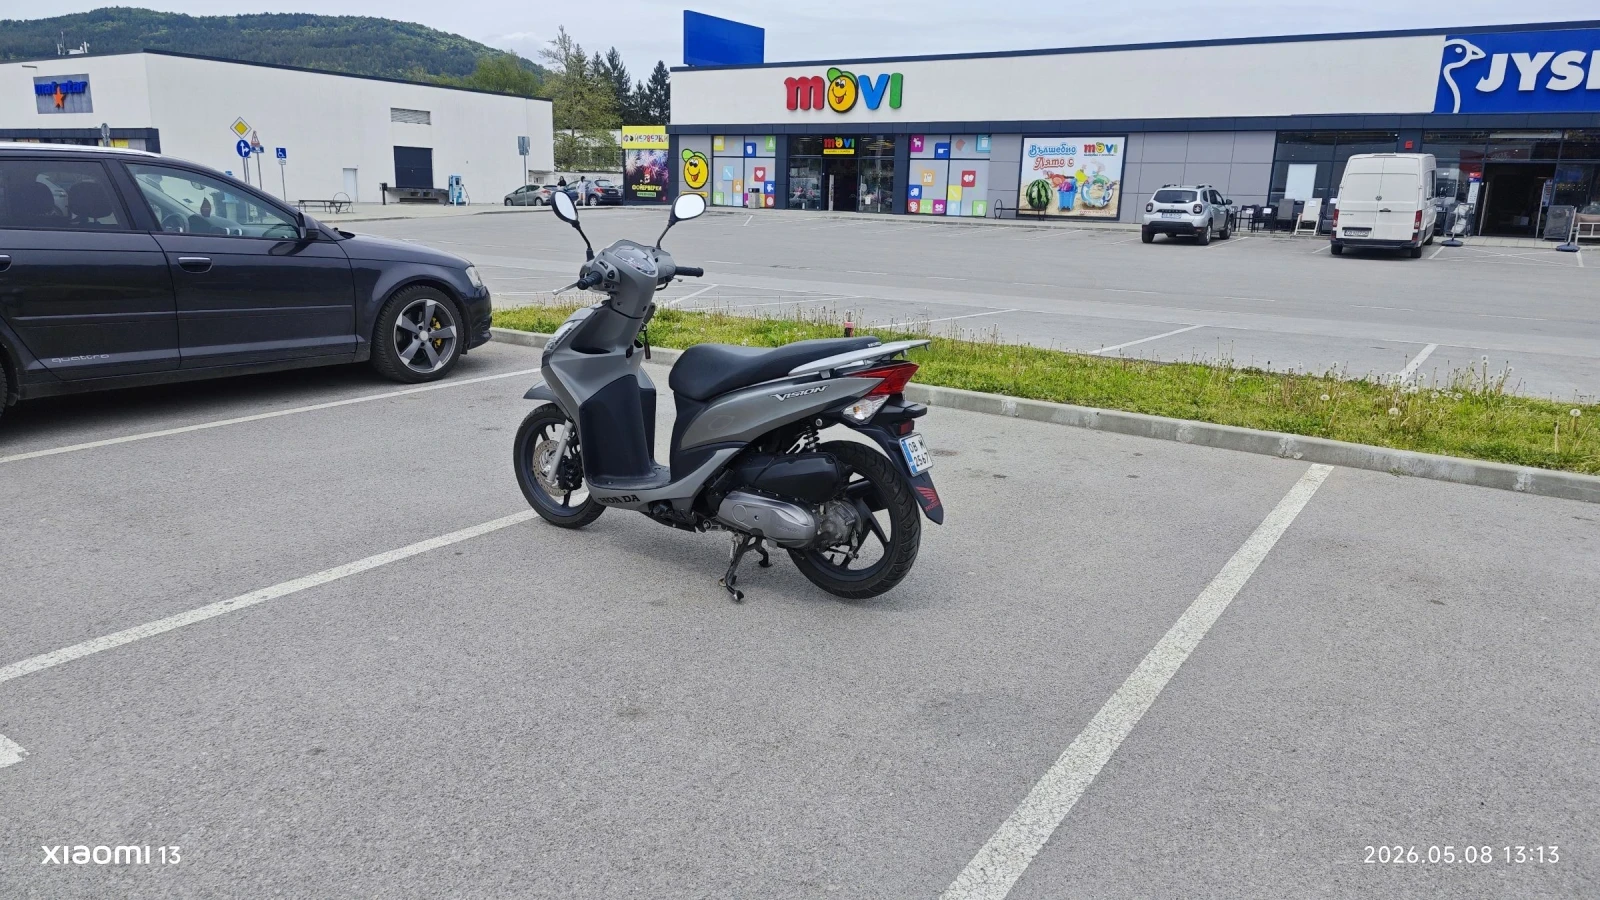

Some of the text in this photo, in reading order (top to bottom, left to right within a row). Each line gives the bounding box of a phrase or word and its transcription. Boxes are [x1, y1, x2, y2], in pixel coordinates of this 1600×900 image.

[1029, 142, 1077, 157] Вълшебно
[1033, 157, 1065, 170] Лято
[52, 354, 109, 363] quattro
[598, 494, 641, 503] HONDA
